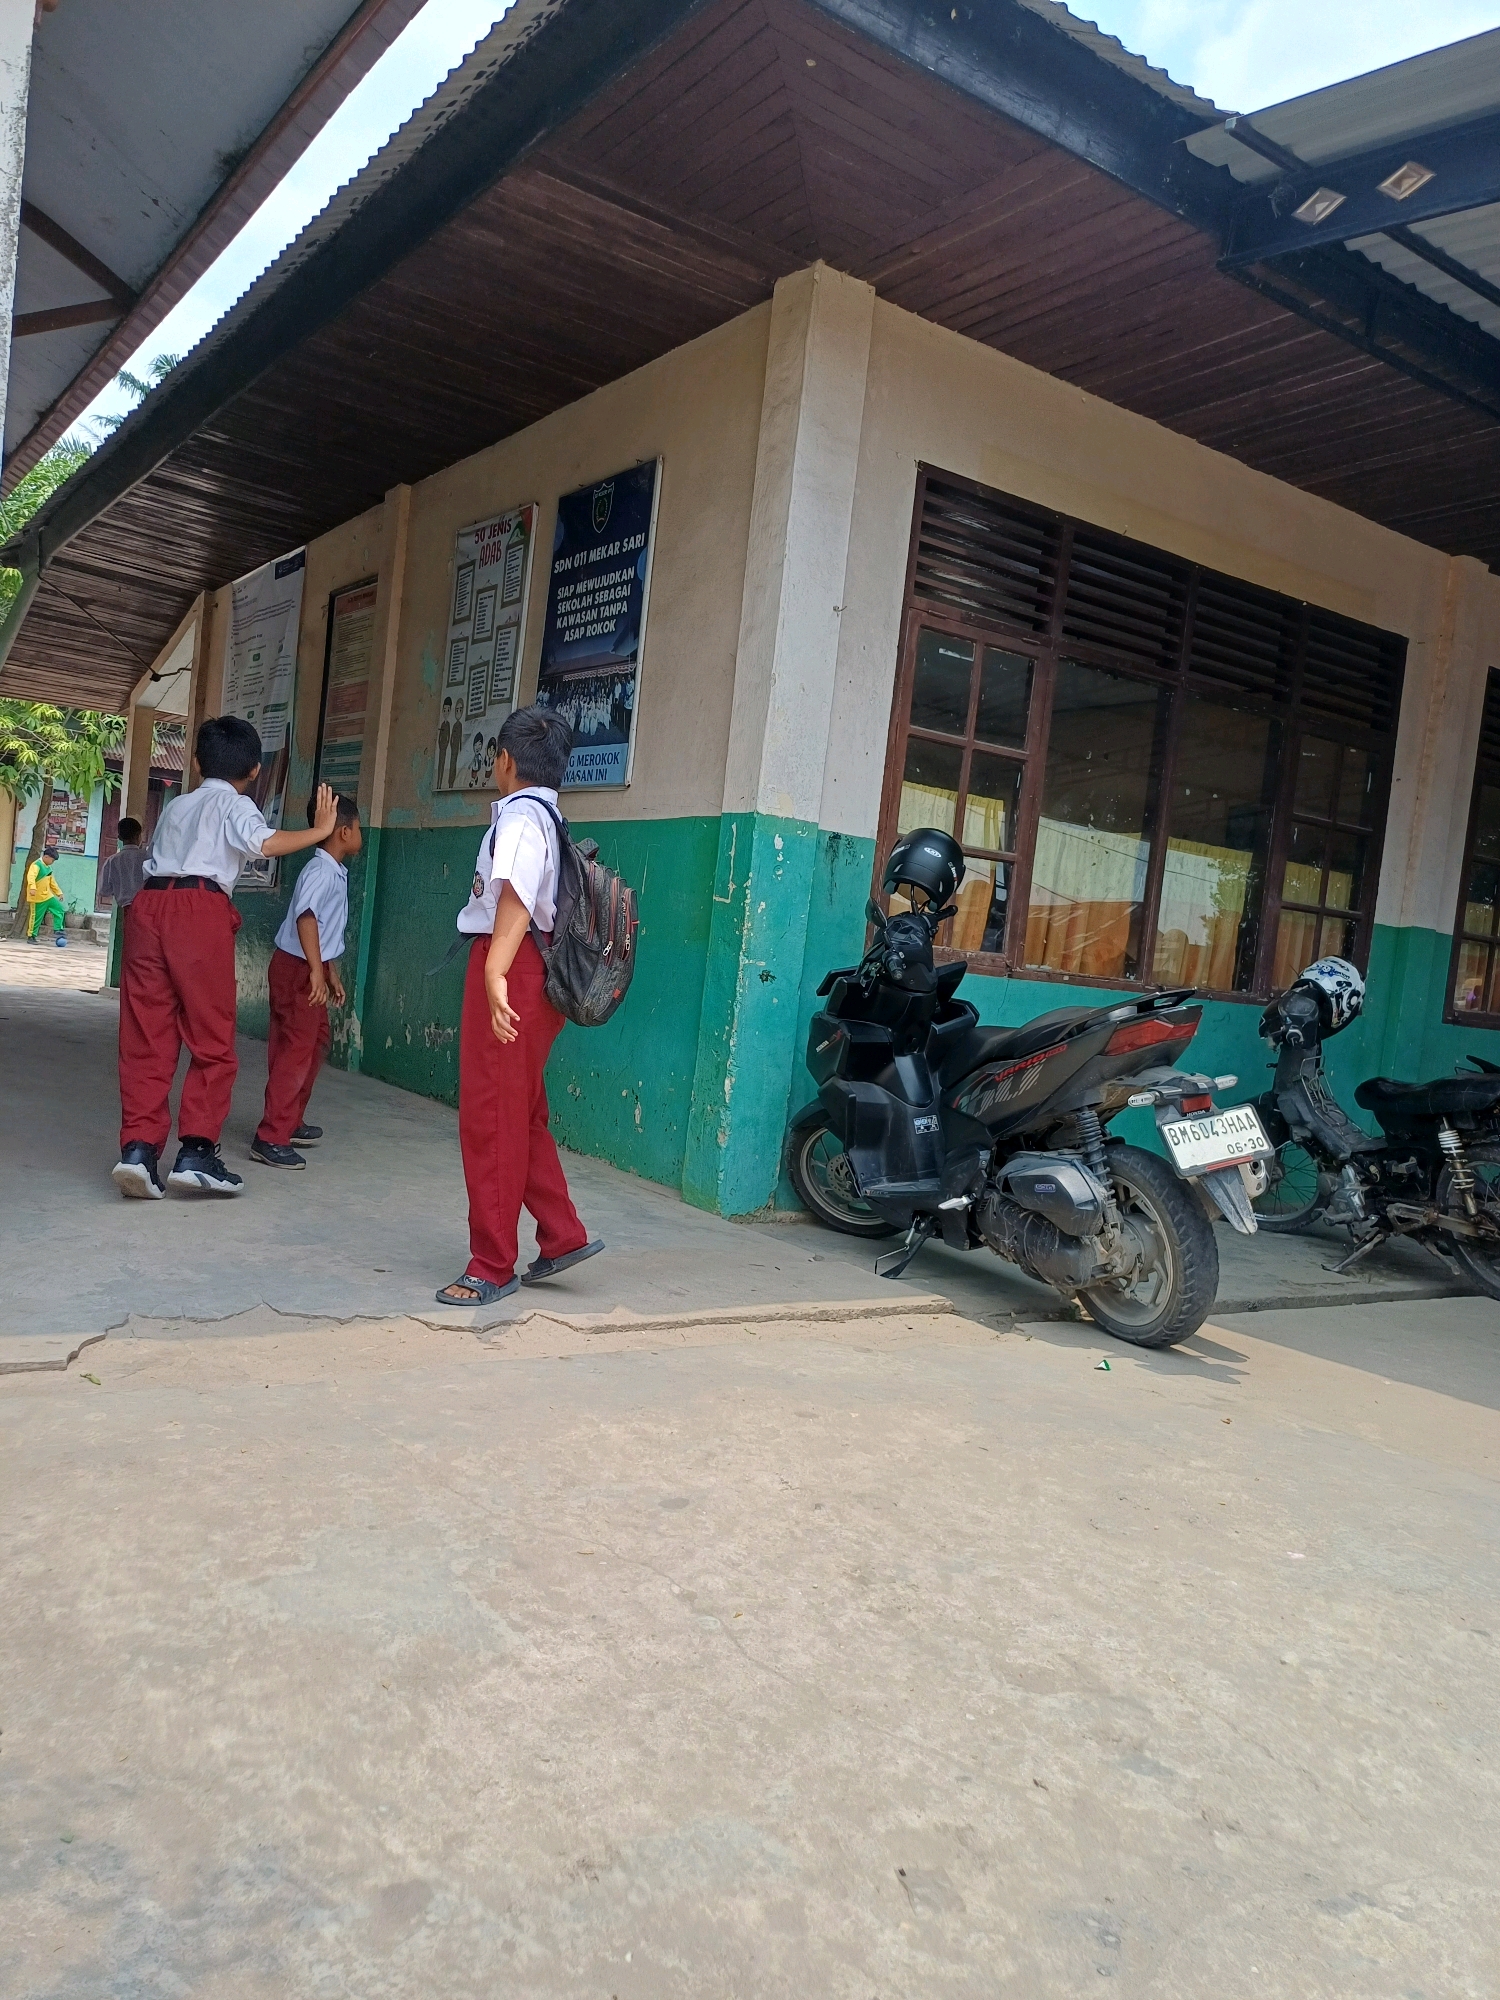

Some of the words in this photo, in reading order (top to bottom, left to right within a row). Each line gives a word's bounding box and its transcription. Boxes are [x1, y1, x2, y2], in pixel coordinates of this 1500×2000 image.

[474, 526, 486, 545] 50
[487, 517, 512, 540] JENIS
[478, 539, 502, 570] ADAB
[553, 555, 573, 574] SDN
[574, 550, 588, 568] 011
[588, 541, 621, 563] MEKAR
[622, 532, 645, 553] SARI
[556, 584, 575, 600] SIAP
[575, 565, 635, 595] MEWUJUDKAN
[556, 593, 593, 615] SEKOLAH
[594, 583, 632, 605] SEBAGAI
[556, 607, 599, 630] KAWASAN
[599, 600, 628, 619] TANPA
[563, 626, 585, 643] ASAP
[585, 618, 617, 638] ROKOK
[576, 751, 621, 767] MEROKOK
[594, 768, 608, 781] INI
[994, 1053, 1046, 1082] VARIO
[1186, 1109, 1206, 1118] HONDA
